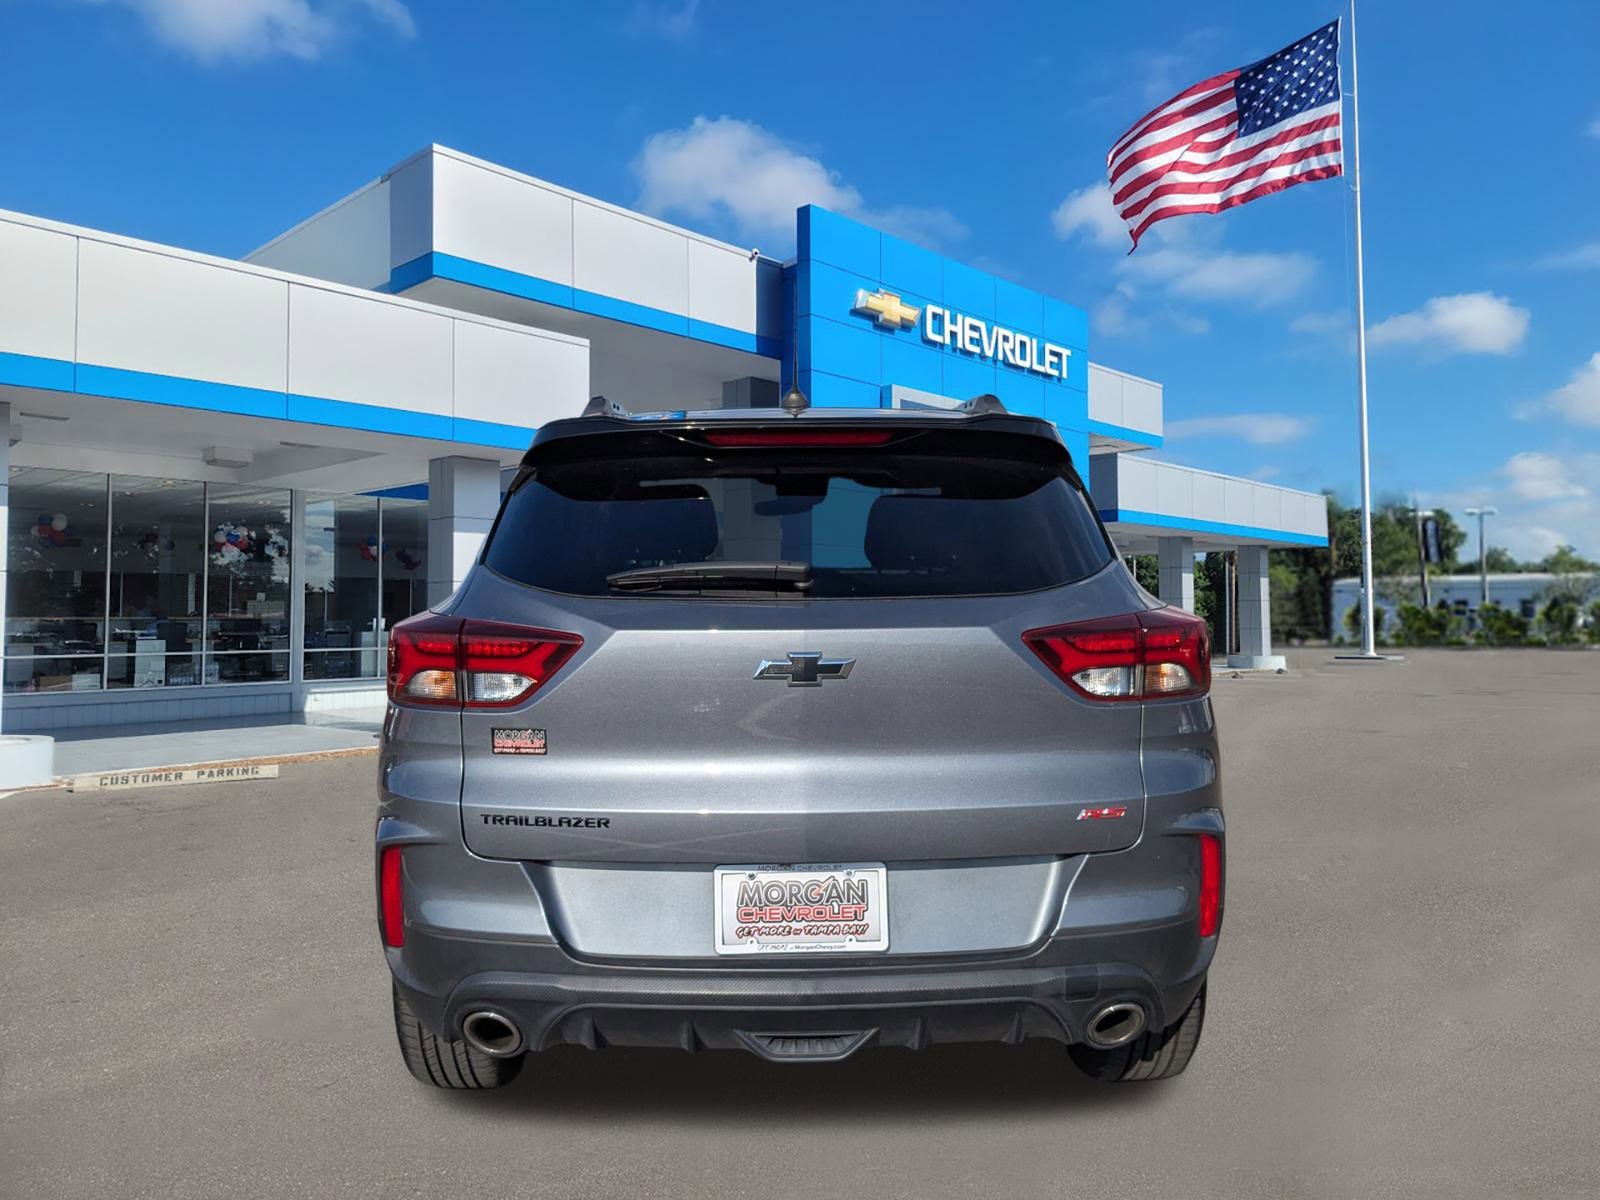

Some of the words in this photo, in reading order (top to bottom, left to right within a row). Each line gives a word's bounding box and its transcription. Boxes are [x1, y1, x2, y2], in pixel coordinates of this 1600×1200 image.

[925, 303, 1072, 379] CHEVROLET
[495, 729, 545, 740] MORGAN
[99, 772, 183, 786] CUSTOMER
[196, 766, 260, 779] PARKING
[480, 813, 610, 828] TRAILBLAZER
[737, 877, 868, 907] MORGAN
[737, 905, 868, 923] CHEVROLET
[736, 925, 759, 938] GET
[758, 924, 791, 936] MORE
[803, 925, 841, 936] TAMPA
